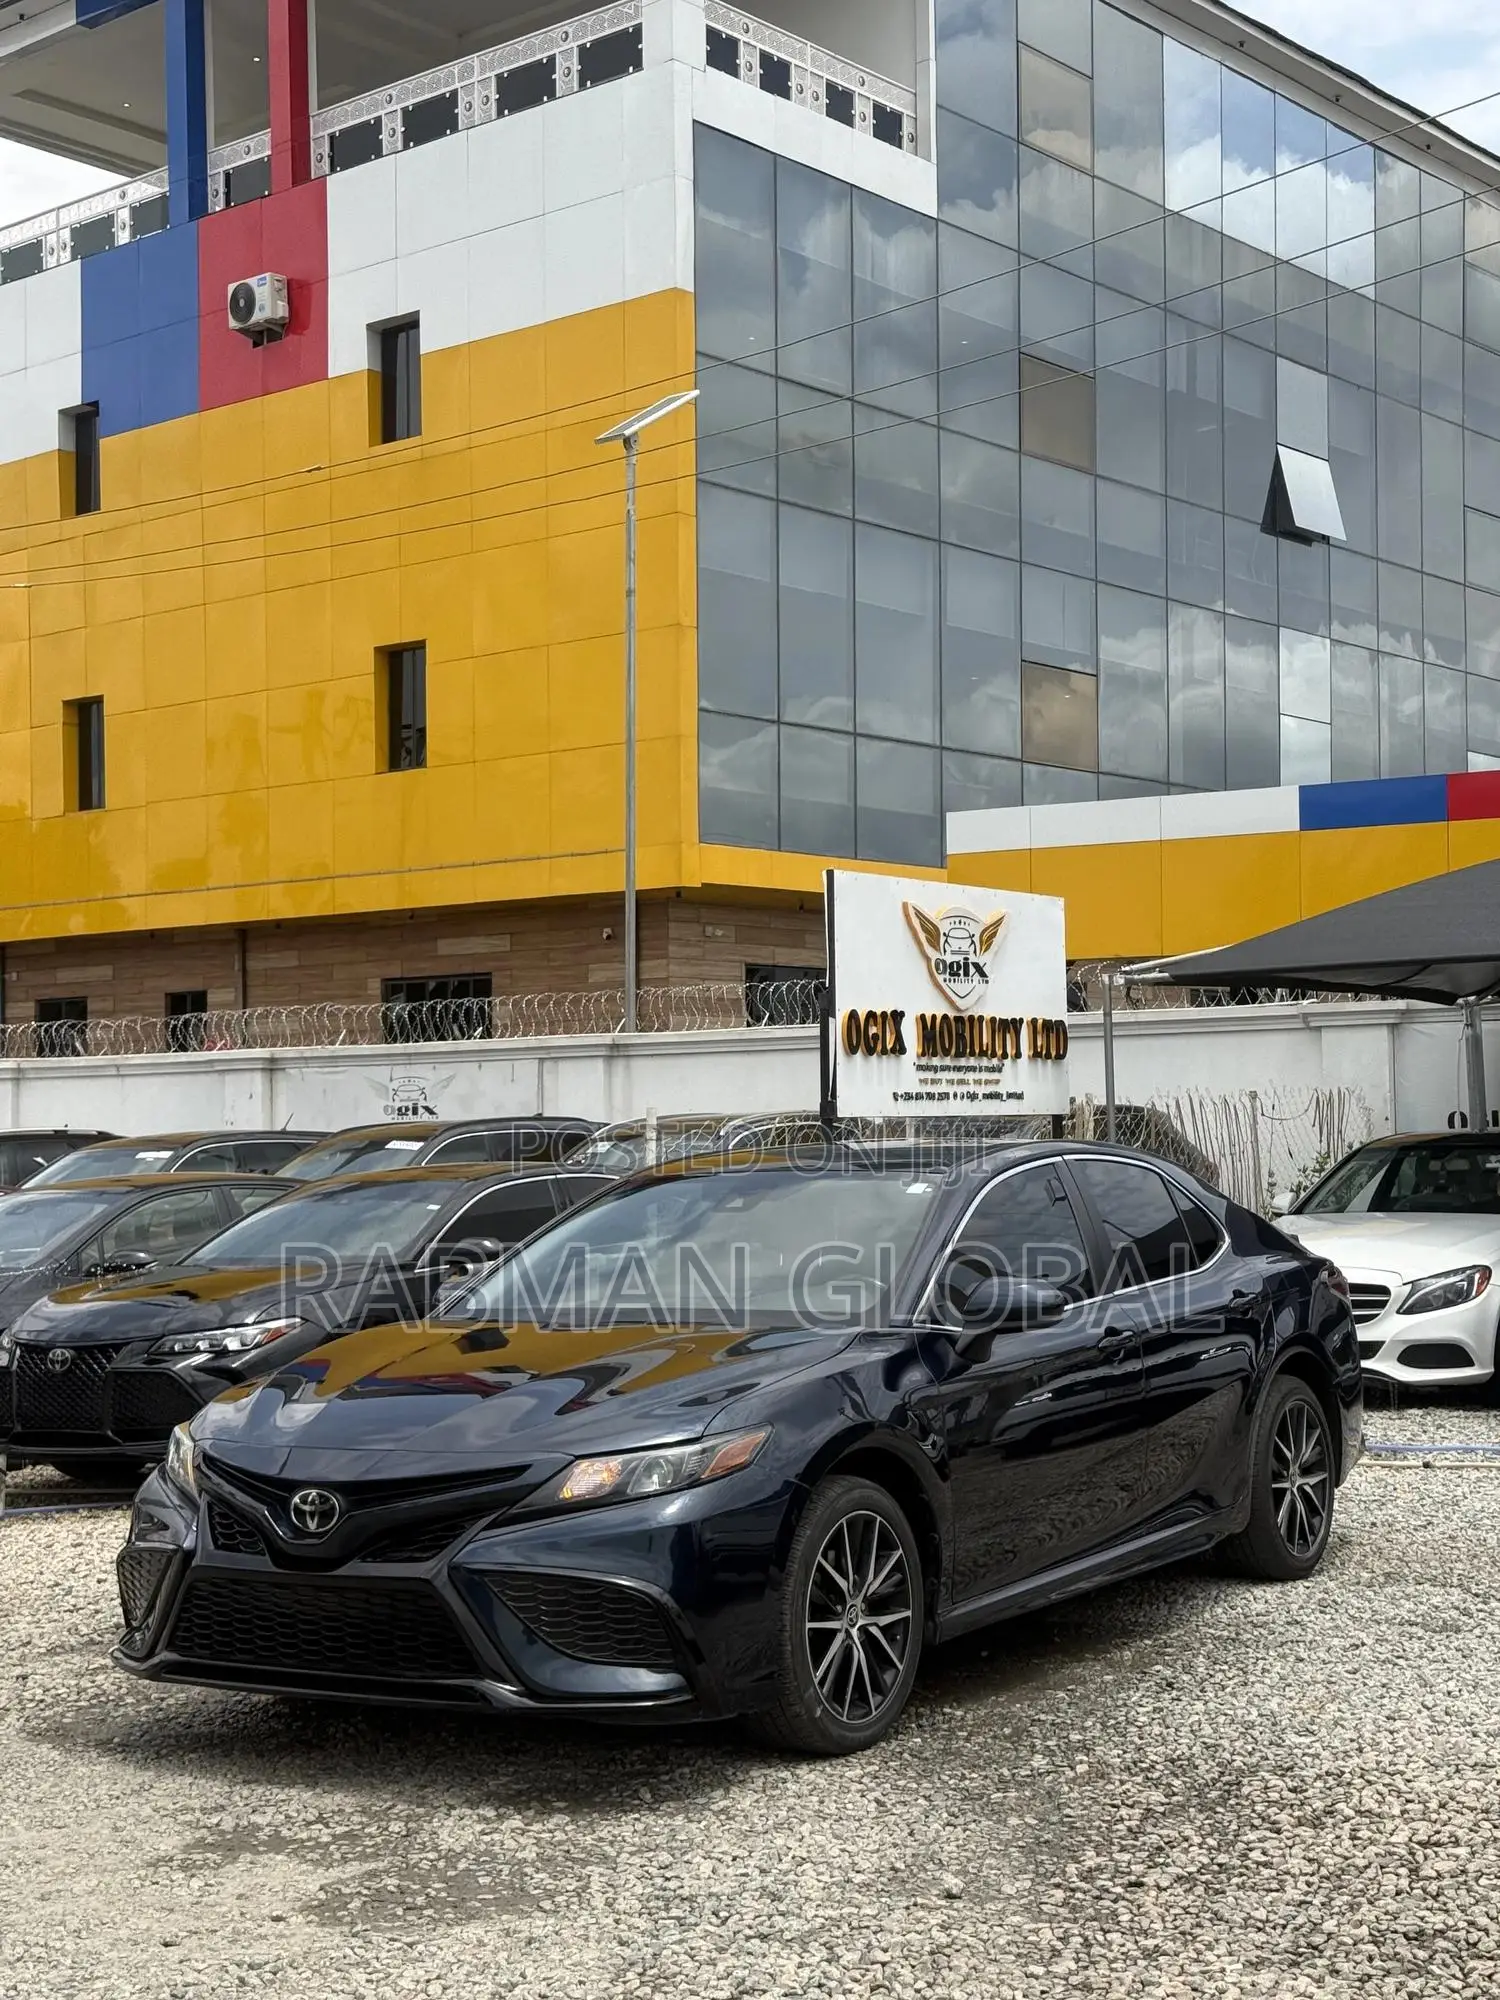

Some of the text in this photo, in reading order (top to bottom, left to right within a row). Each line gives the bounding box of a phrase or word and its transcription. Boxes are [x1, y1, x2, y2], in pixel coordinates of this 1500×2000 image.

[841, 1008, 1068, 1060] OGIX MOBILITY LTD
[939, 1064, 952, 1073] sure
[952, 1064, 977, 1075] everyone
[978, 1063, 983, 1073] is
